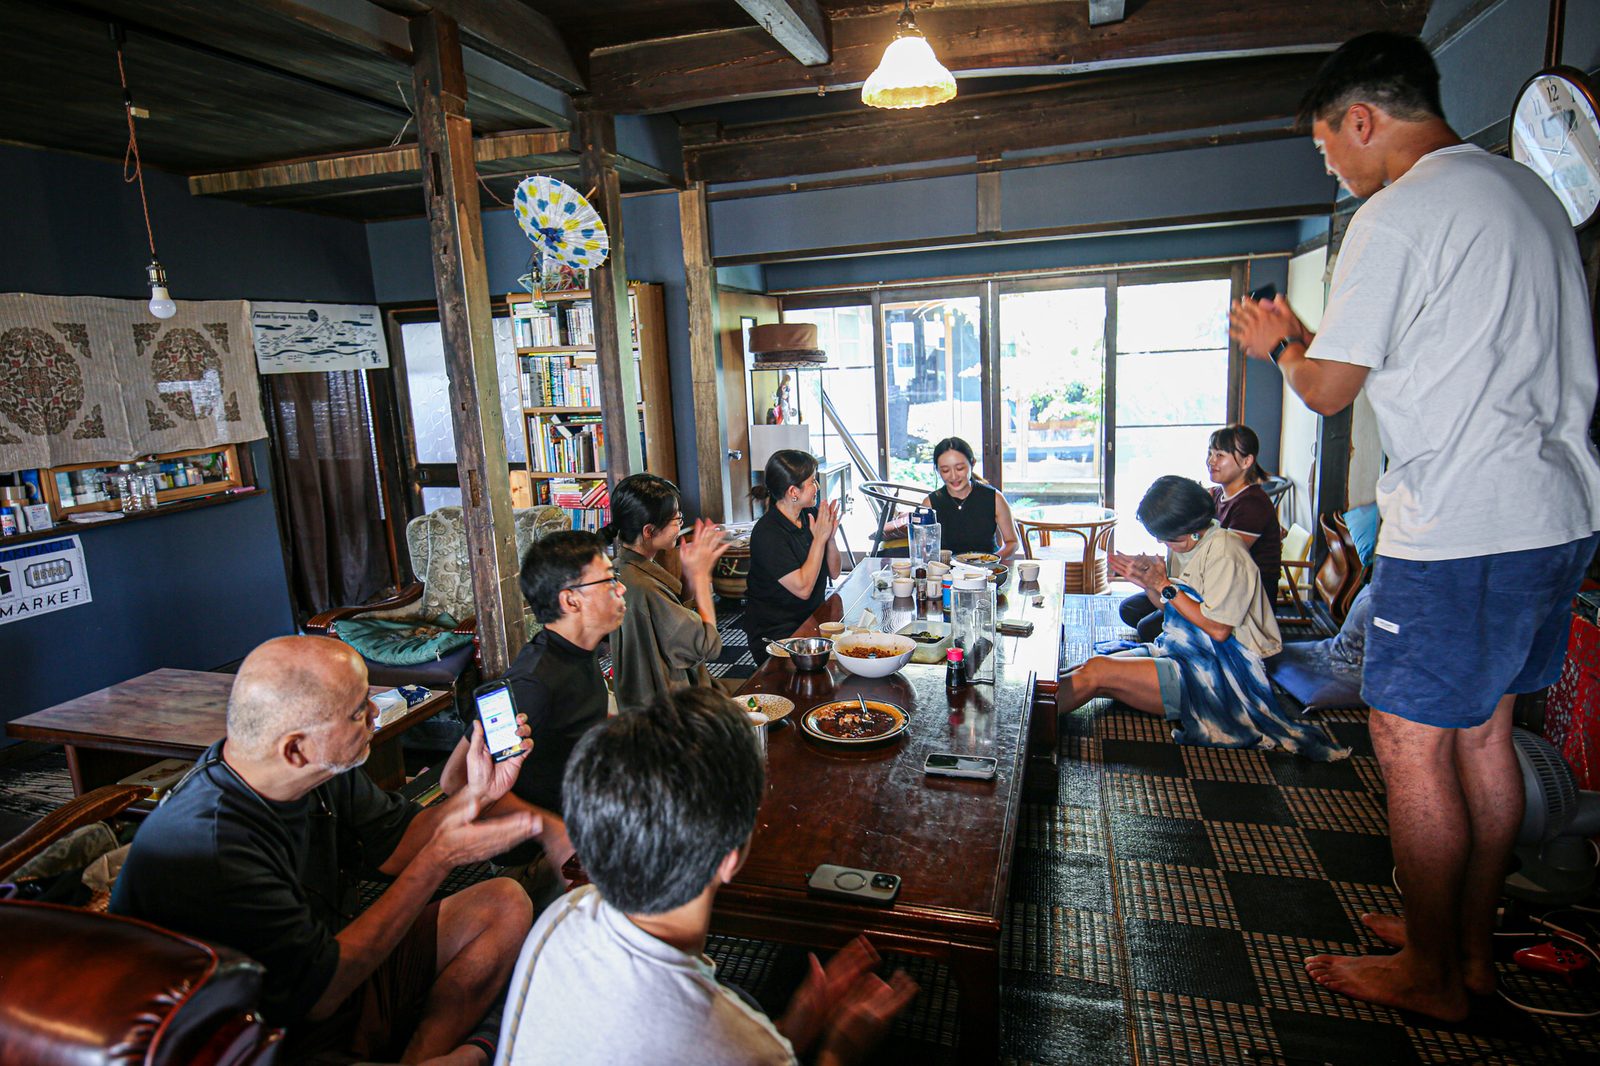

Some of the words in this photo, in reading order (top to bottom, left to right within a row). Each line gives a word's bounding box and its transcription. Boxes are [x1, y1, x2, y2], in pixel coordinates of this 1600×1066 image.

[1546, 84, 1559, 103] 12
[1531, 96, 1542, 116] 11
[0, 588, 80, 618] MARKET
